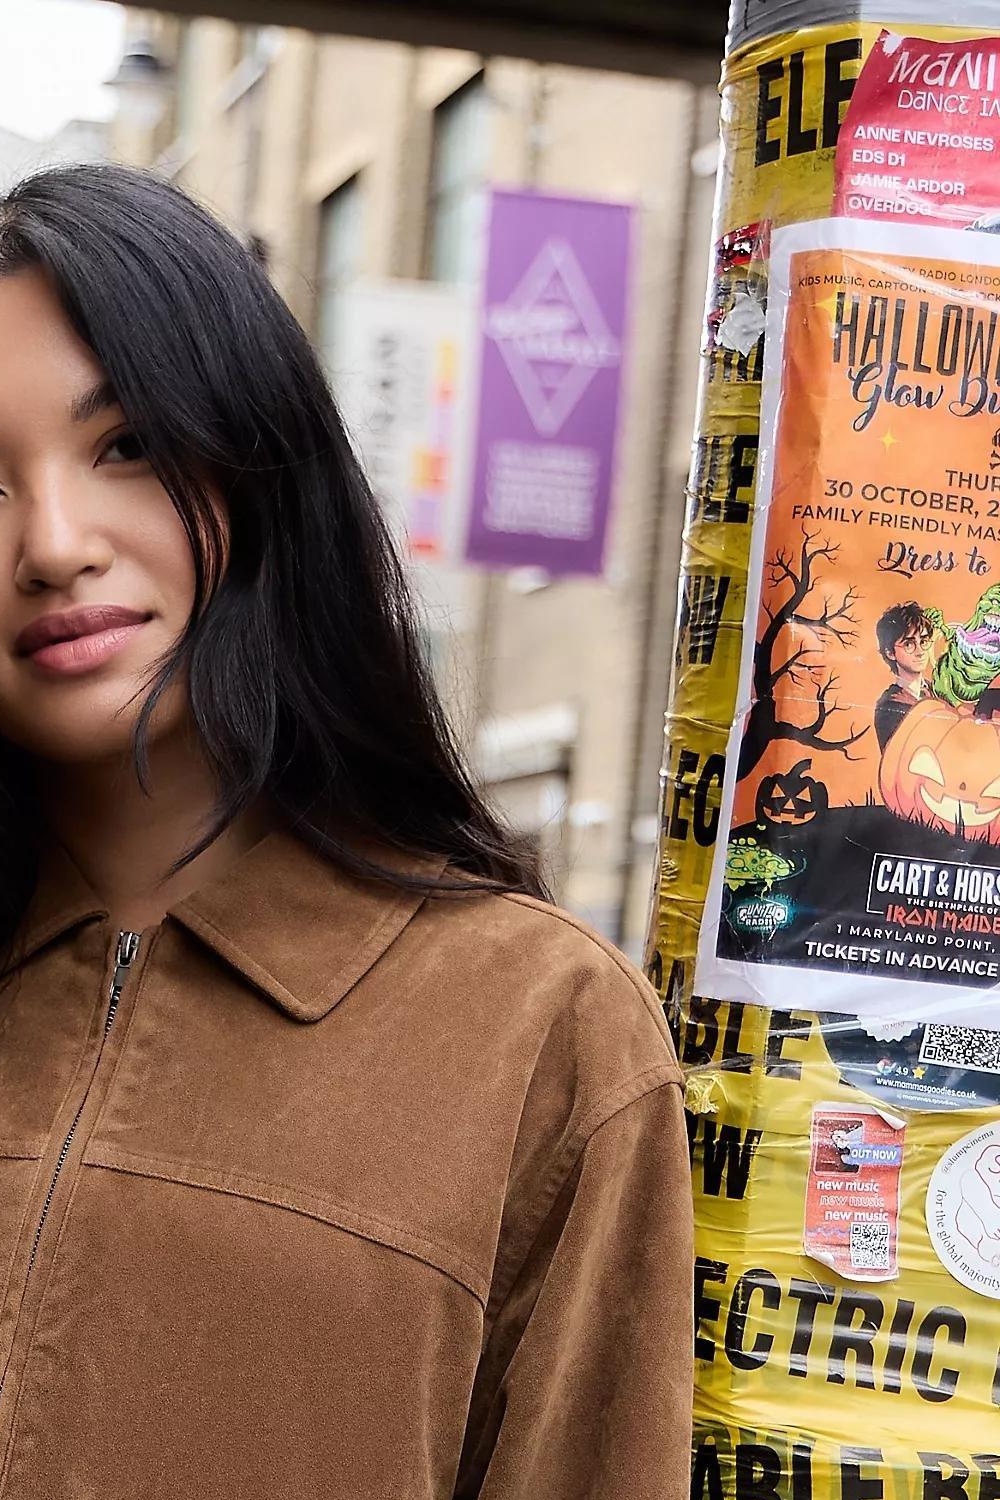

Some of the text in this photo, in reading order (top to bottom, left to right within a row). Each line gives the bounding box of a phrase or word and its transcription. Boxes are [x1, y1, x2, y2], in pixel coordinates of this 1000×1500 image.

[853, 125, 994, 152] ANNE NEVROSES
[852, 150, 886, 164] EDS
[850, 173, 966, 196] JAMIE ARDOR
[797, 274, 822, 288] KIDS
[823, 274, 866, 289] MUSIC,
[919, 267, 957, 281] RADIO
[832, 291, 1000, 381] HALLOW
[847, 361, 944, 433] Glow
[824, 479, 854, 499] 30
[860, 483, 980, 519] OCTOBER,
[791, 504, 864, 524] FAMILY
[868, 511, 962, 537] FRIENDLY
[875, 541, 992, 579] Dress to
[875, 859, 936, 898] CART
[935, 869, 950, 897] &
[885, 904, 938, 931] IRON
[906, 897, 999, 915] THE BIRTHPLACE OF
[836, 924, 996, 954] 1 MARYLAND POINT,
[804, 940, 1000, 978] TICKETS IN ADVANCE
[875, 1077, 977, 1100] www.mammasgoodies.co.uk
[850, 1148, 898, 1161] OUT NOW
[816, 1180, 880, 1192] new music
[819, 1195, 885, 1208] new music
[824, 1210, 889, 1223] new music
[935, 1189, 1000, 1292] for the global majority
